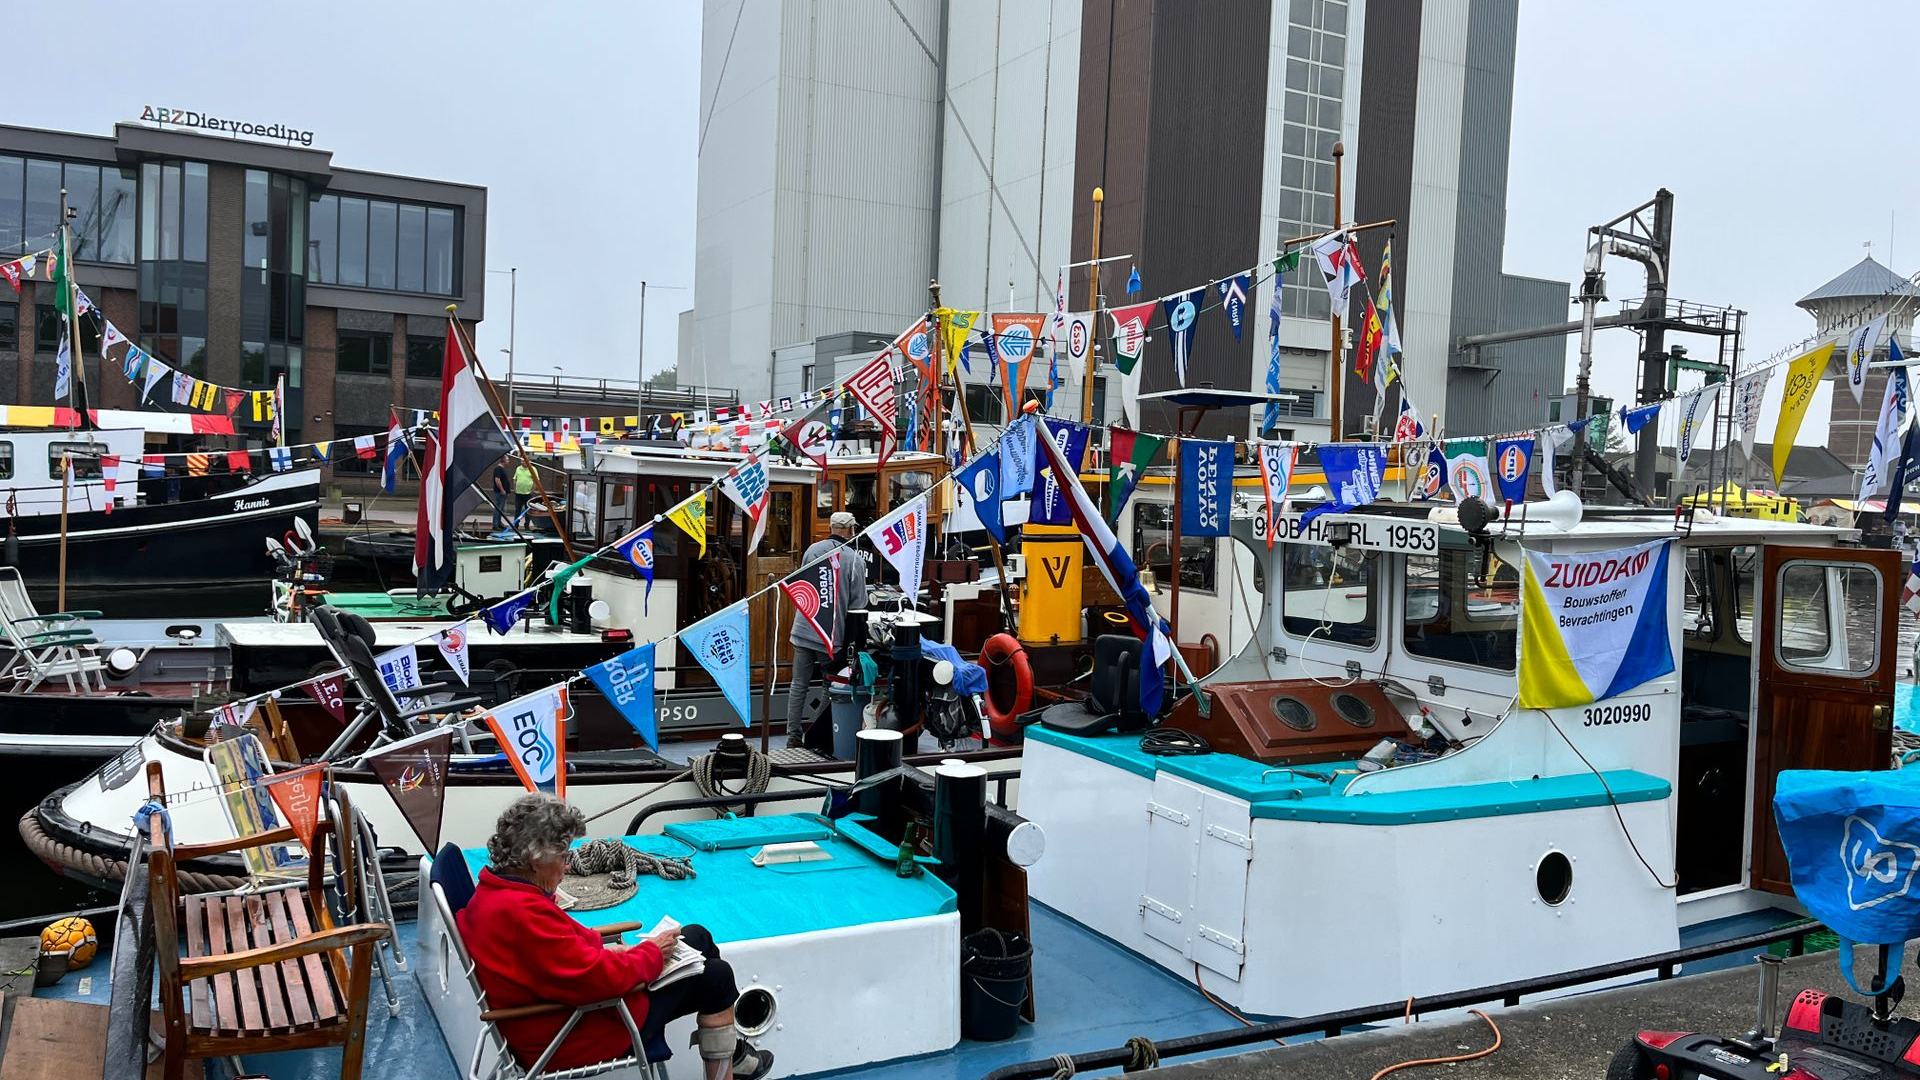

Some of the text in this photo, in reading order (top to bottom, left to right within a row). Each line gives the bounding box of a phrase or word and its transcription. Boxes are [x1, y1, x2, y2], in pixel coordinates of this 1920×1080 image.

[233, 497, 270, 511] Hannie
[1254, 516, 1436, 551] 90B HARL. 1953
[857, 549, 873, 563] ORA
[1544, 550, 1650, 589] ZUIDDAM
[1563, 587, 1627, 608] Bouwstoffen
[1559, 604, 1633, 628] Bevrachtingen
[721, 630, 735, 661] DAGEN
[656, 705, 698, 722] PSO
[1583, 703, 1651, 727] 3020990
[513, 710, 543, 765] EOC
